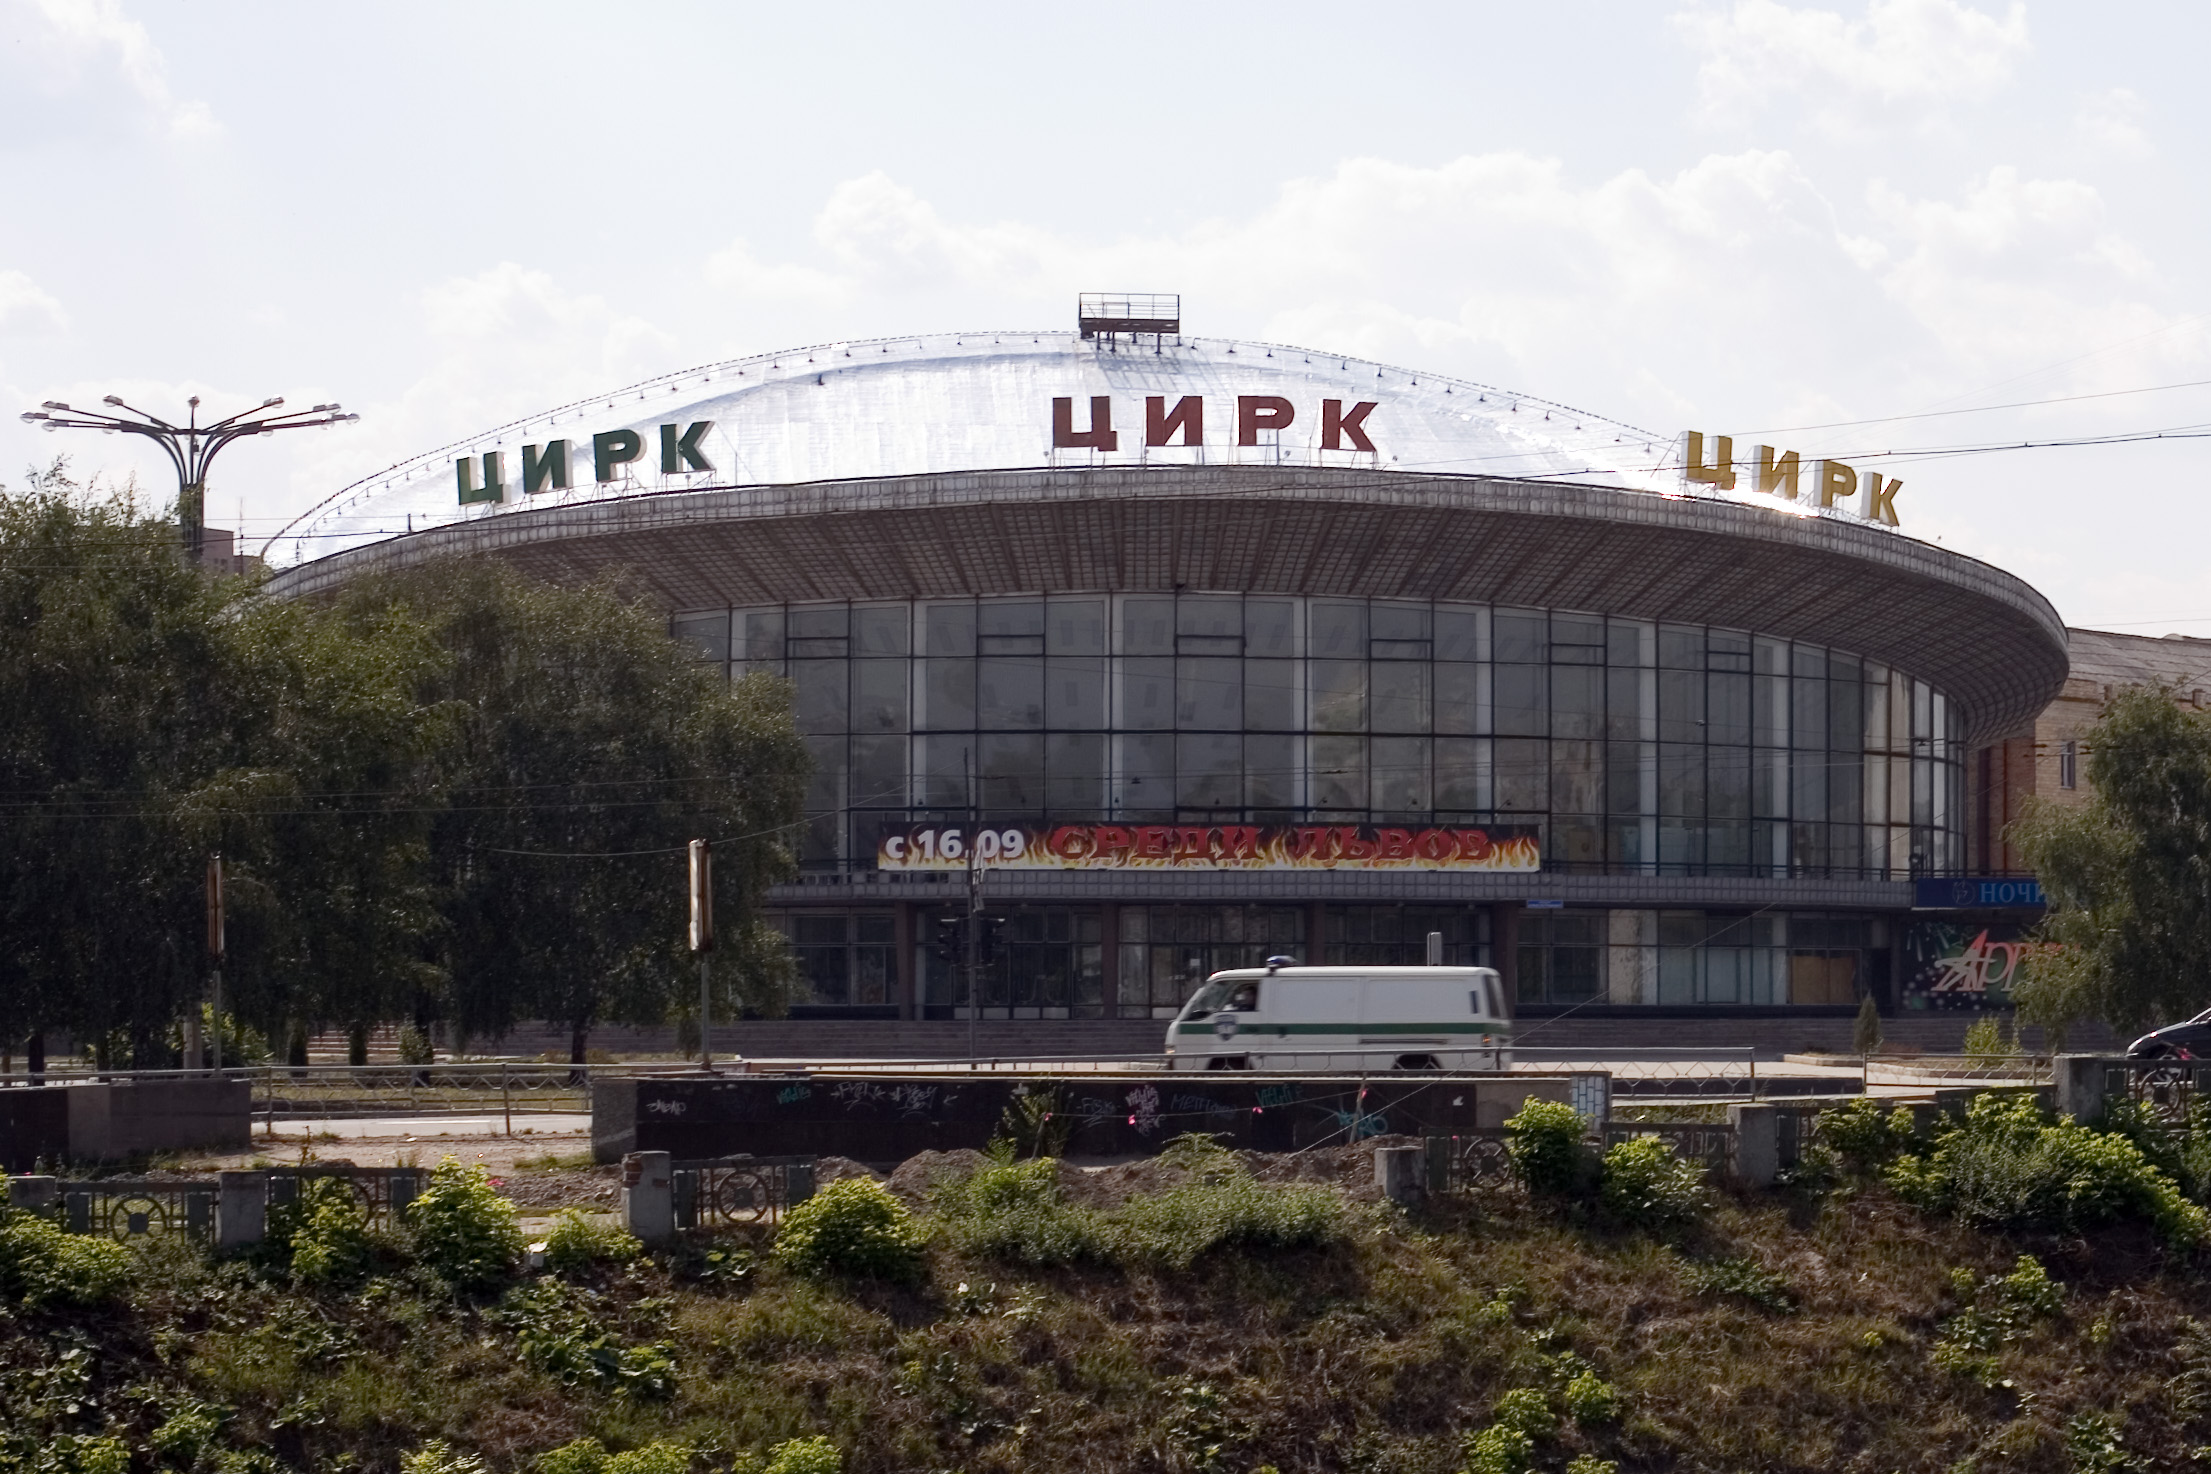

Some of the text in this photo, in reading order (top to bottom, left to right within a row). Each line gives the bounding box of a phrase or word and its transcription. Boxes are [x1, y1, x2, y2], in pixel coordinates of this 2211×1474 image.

[1052, 395, 1379, 453] ЦИРК
[456, 420, 717, 508] ЦИРК
[1679, 430, 1904, 527] ЦИРК
[1050, 826, 1261, 862] СРЕДИ
[1293, 826, 1490, 862] ЛЬВОВ
